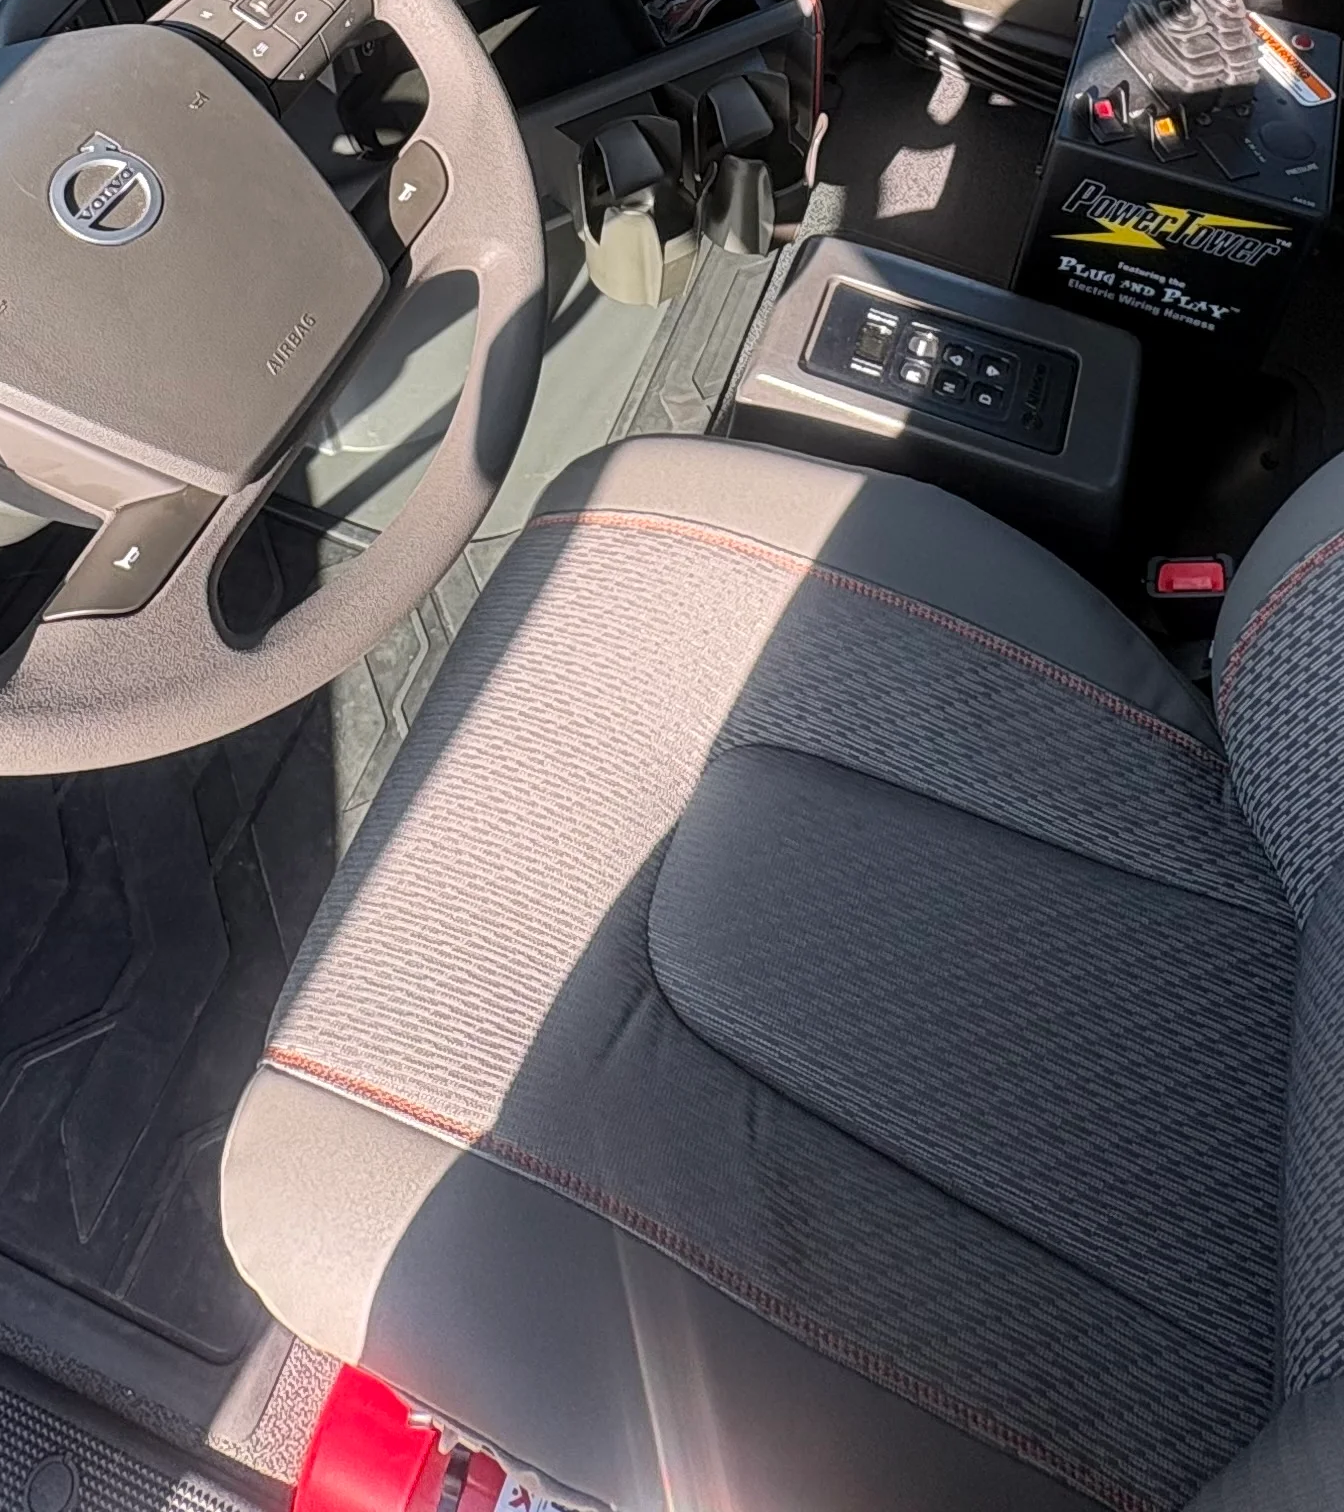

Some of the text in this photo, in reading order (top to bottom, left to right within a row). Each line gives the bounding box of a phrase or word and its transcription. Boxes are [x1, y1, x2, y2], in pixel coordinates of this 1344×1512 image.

[76, 168, 134, 220] VOLVO
[1068, 278, 1216, 332] Electric Wiring Harness
[267, 313, 316, 375] AIRBAG
[979, 393, 992, 406] D
